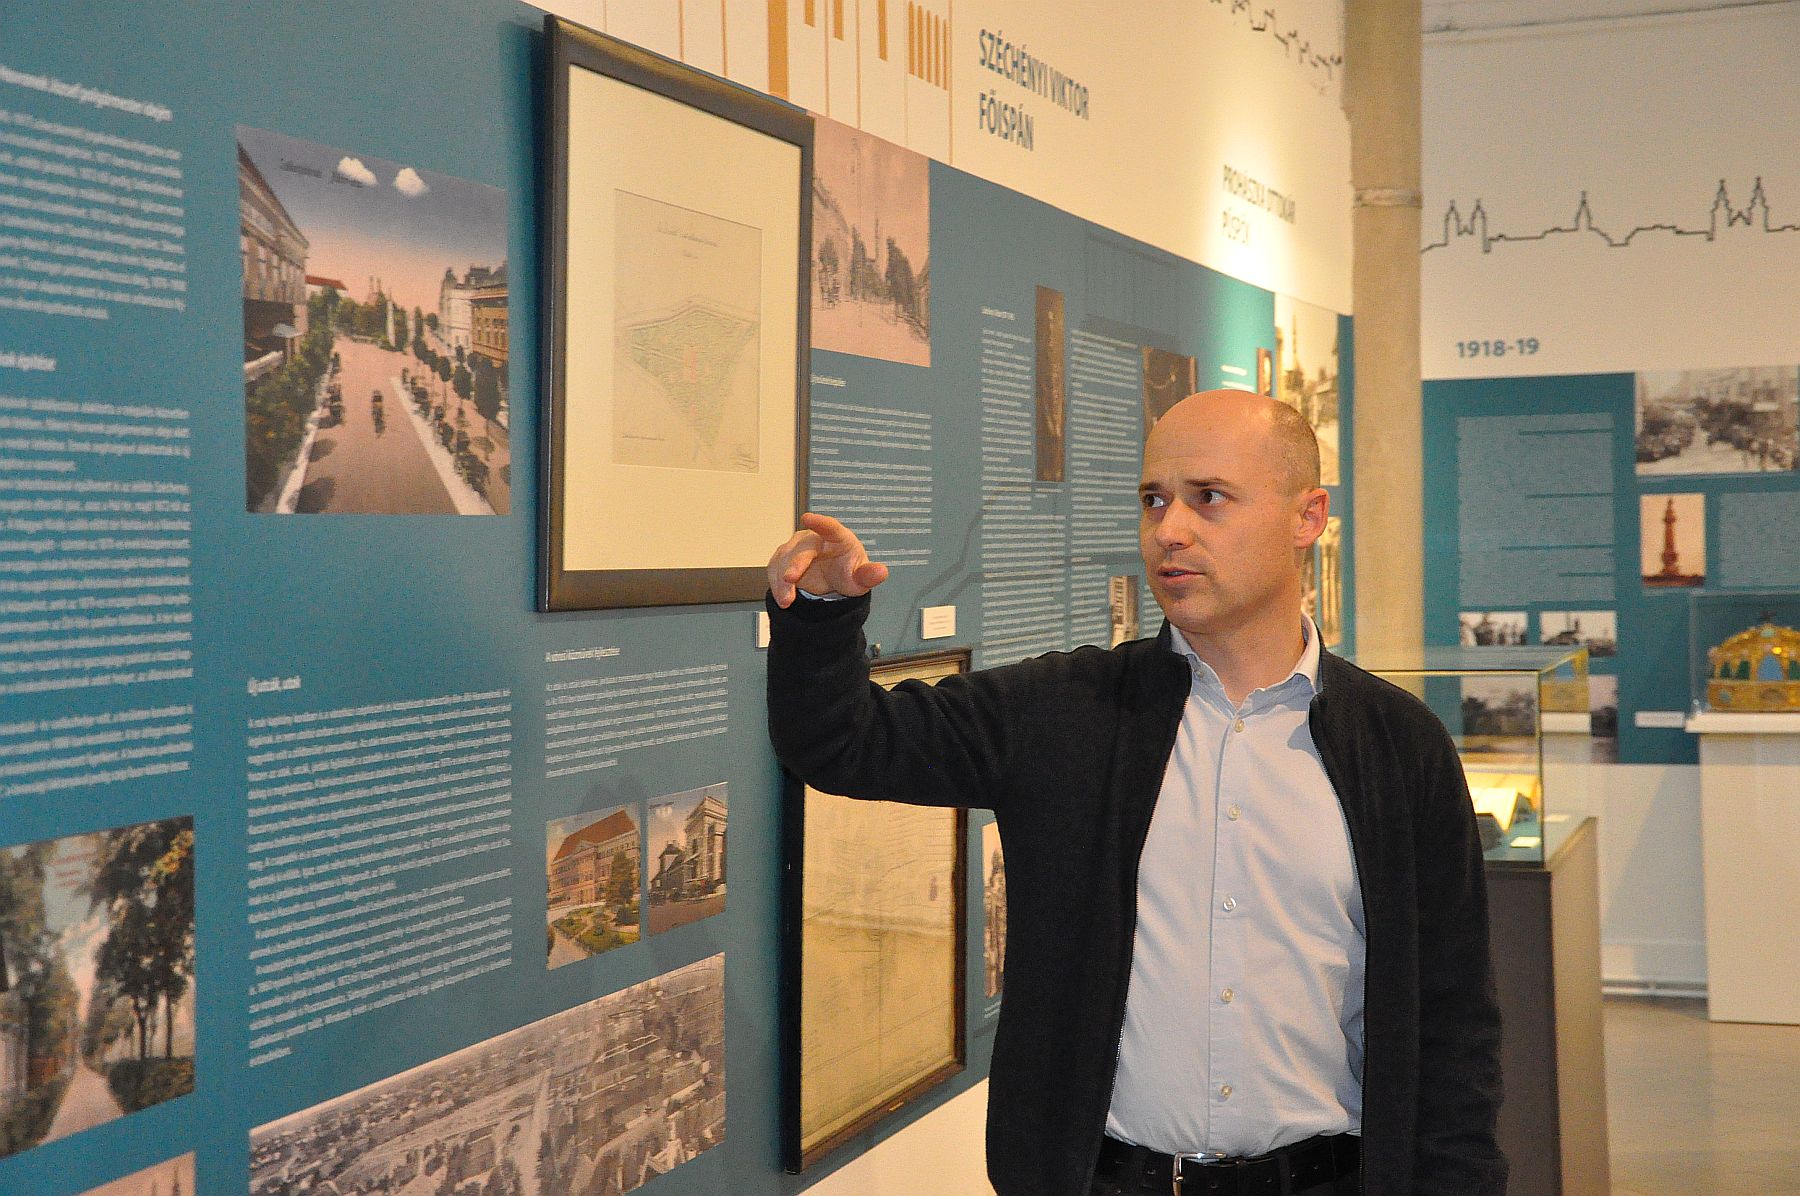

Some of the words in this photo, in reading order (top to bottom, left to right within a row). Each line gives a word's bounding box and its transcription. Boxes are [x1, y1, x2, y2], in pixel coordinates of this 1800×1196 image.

[979, 28, 1048, 98] SZÉCHÉNYI
[1049, 66, 1089, 120] VIKTOR
[979, 88, 1034, 151] FŐISPÁN
[1456, 337, 1540, 358] 1918-19
